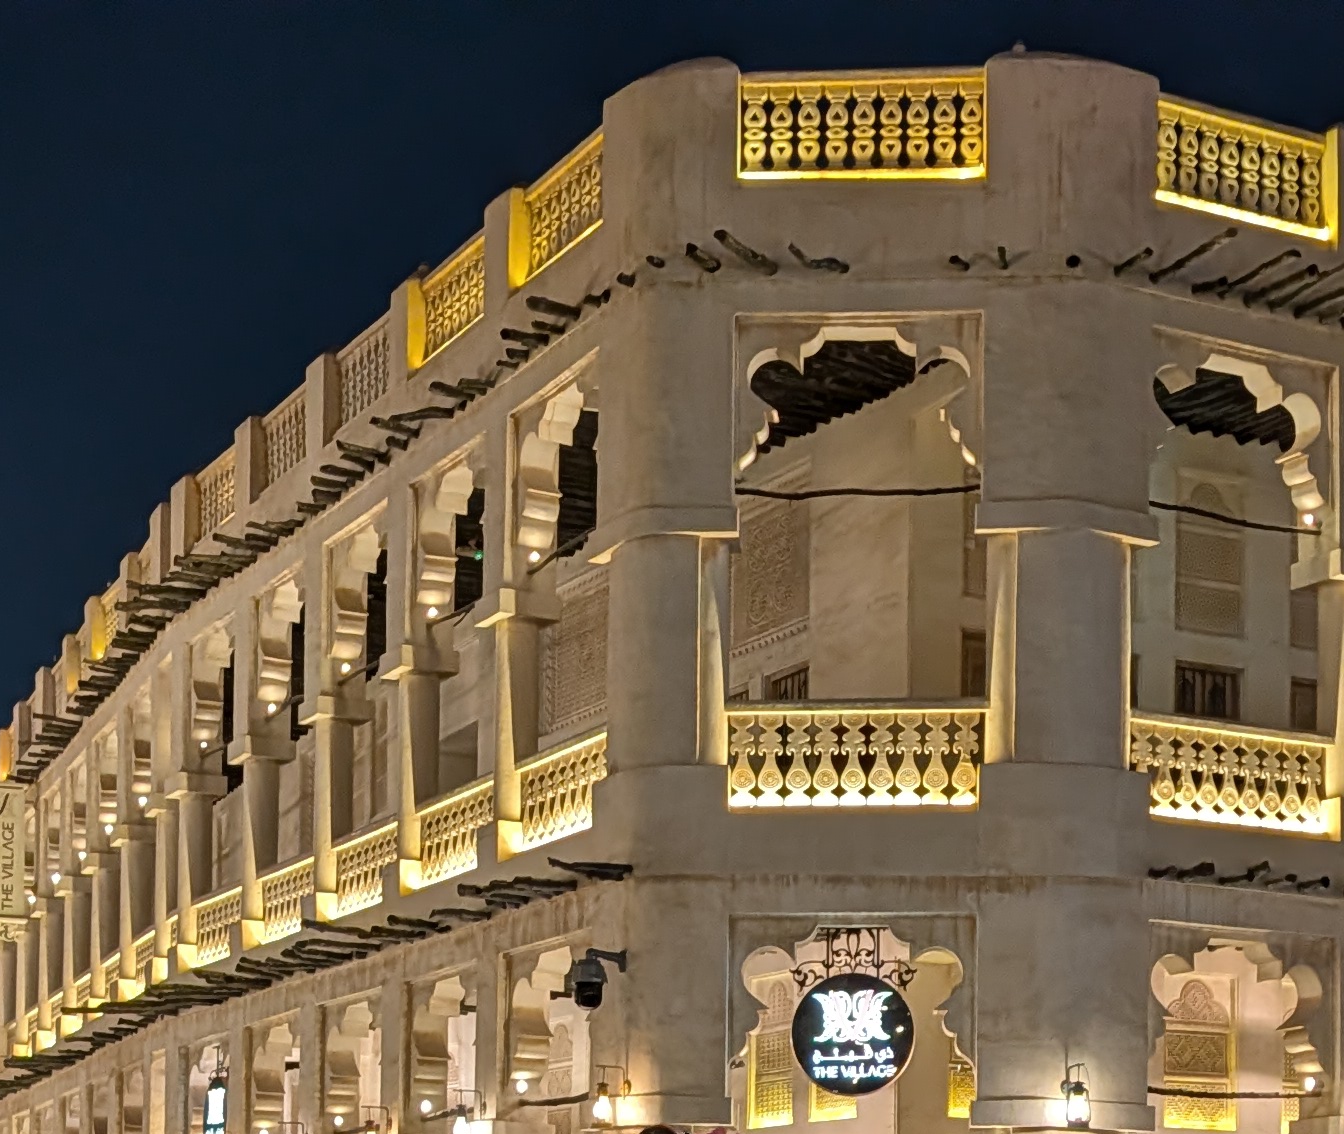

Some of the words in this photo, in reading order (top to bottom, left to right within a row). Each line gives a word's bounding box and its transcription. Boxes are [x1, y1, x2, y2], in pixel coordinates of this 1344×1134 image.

[1, 821, 15, 880] VILLAGE
[1, 883, 14, 910] THE
[813, 1065, 838, 1079] THE
[840, 1064, 897, 1079] VILLAGE
